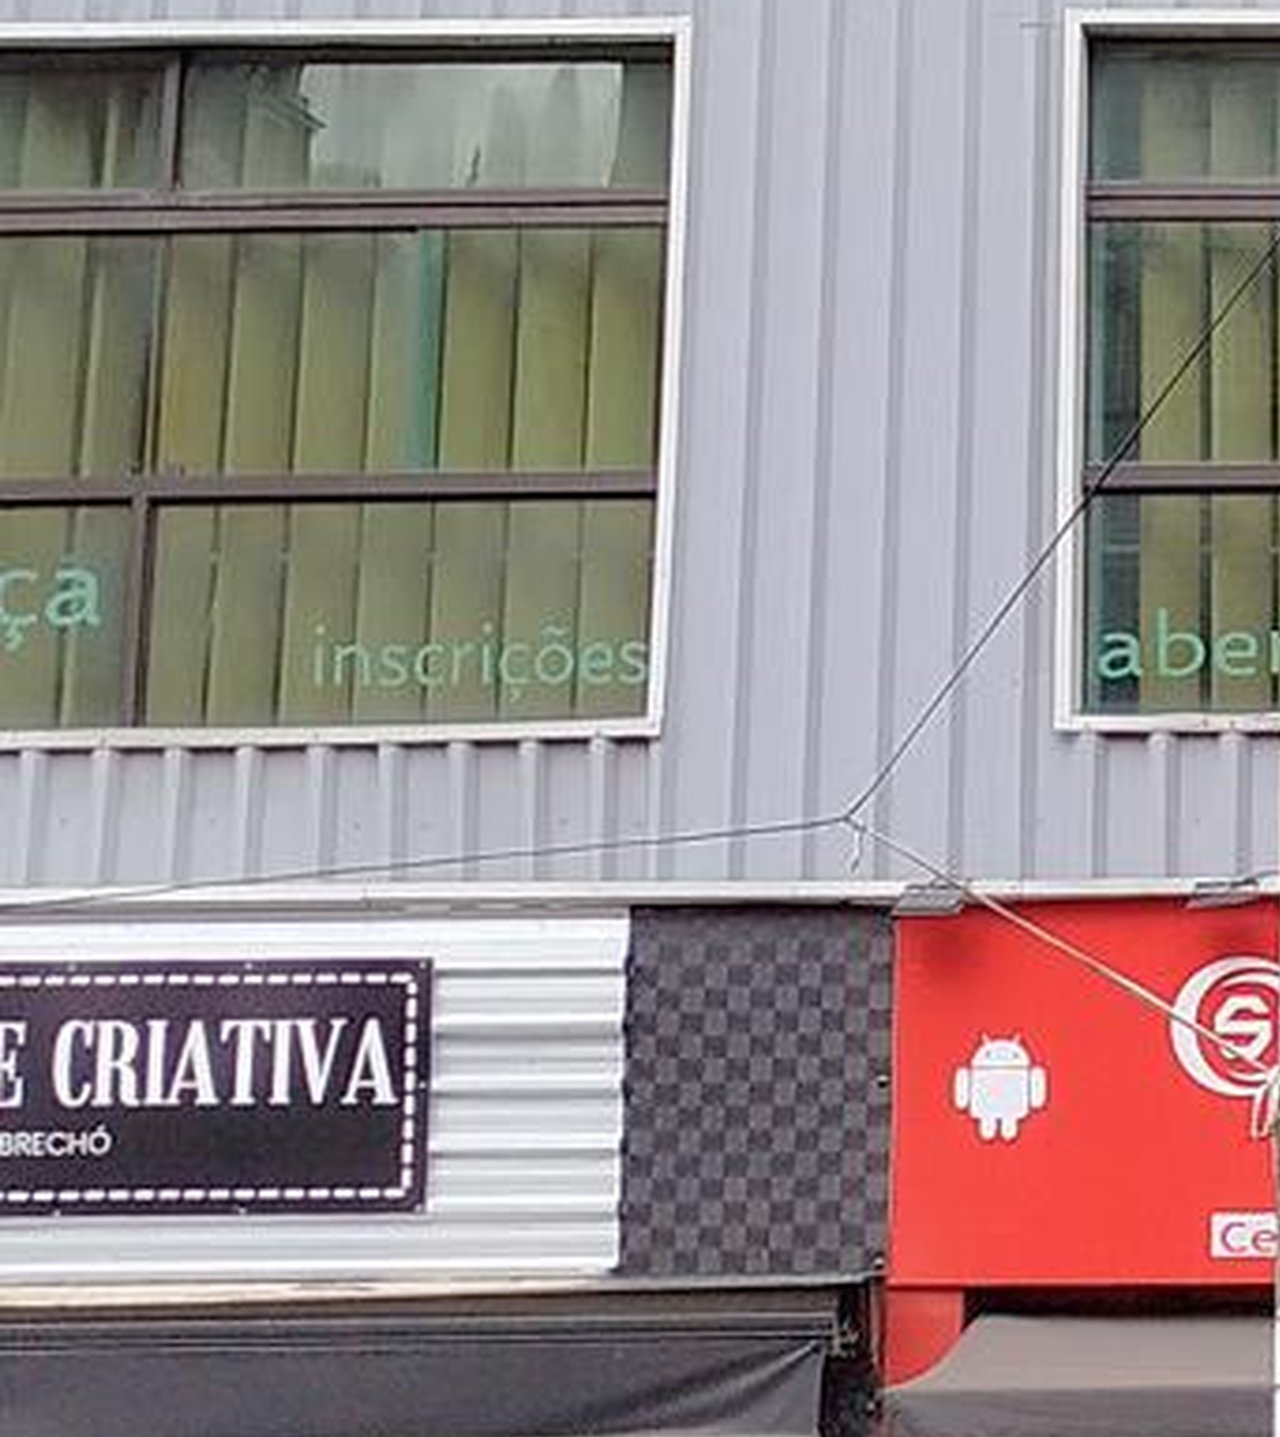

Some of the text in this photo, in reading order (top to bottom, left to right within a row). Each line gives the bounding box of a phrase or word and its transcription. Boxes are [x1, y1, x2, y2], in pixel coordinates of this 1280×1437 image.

[312, 622, 650, 700] inscrições
[52, 1017, 400, 1109] CRIATIVA
[0, 1124, 112, 1157] BRECHÓ
